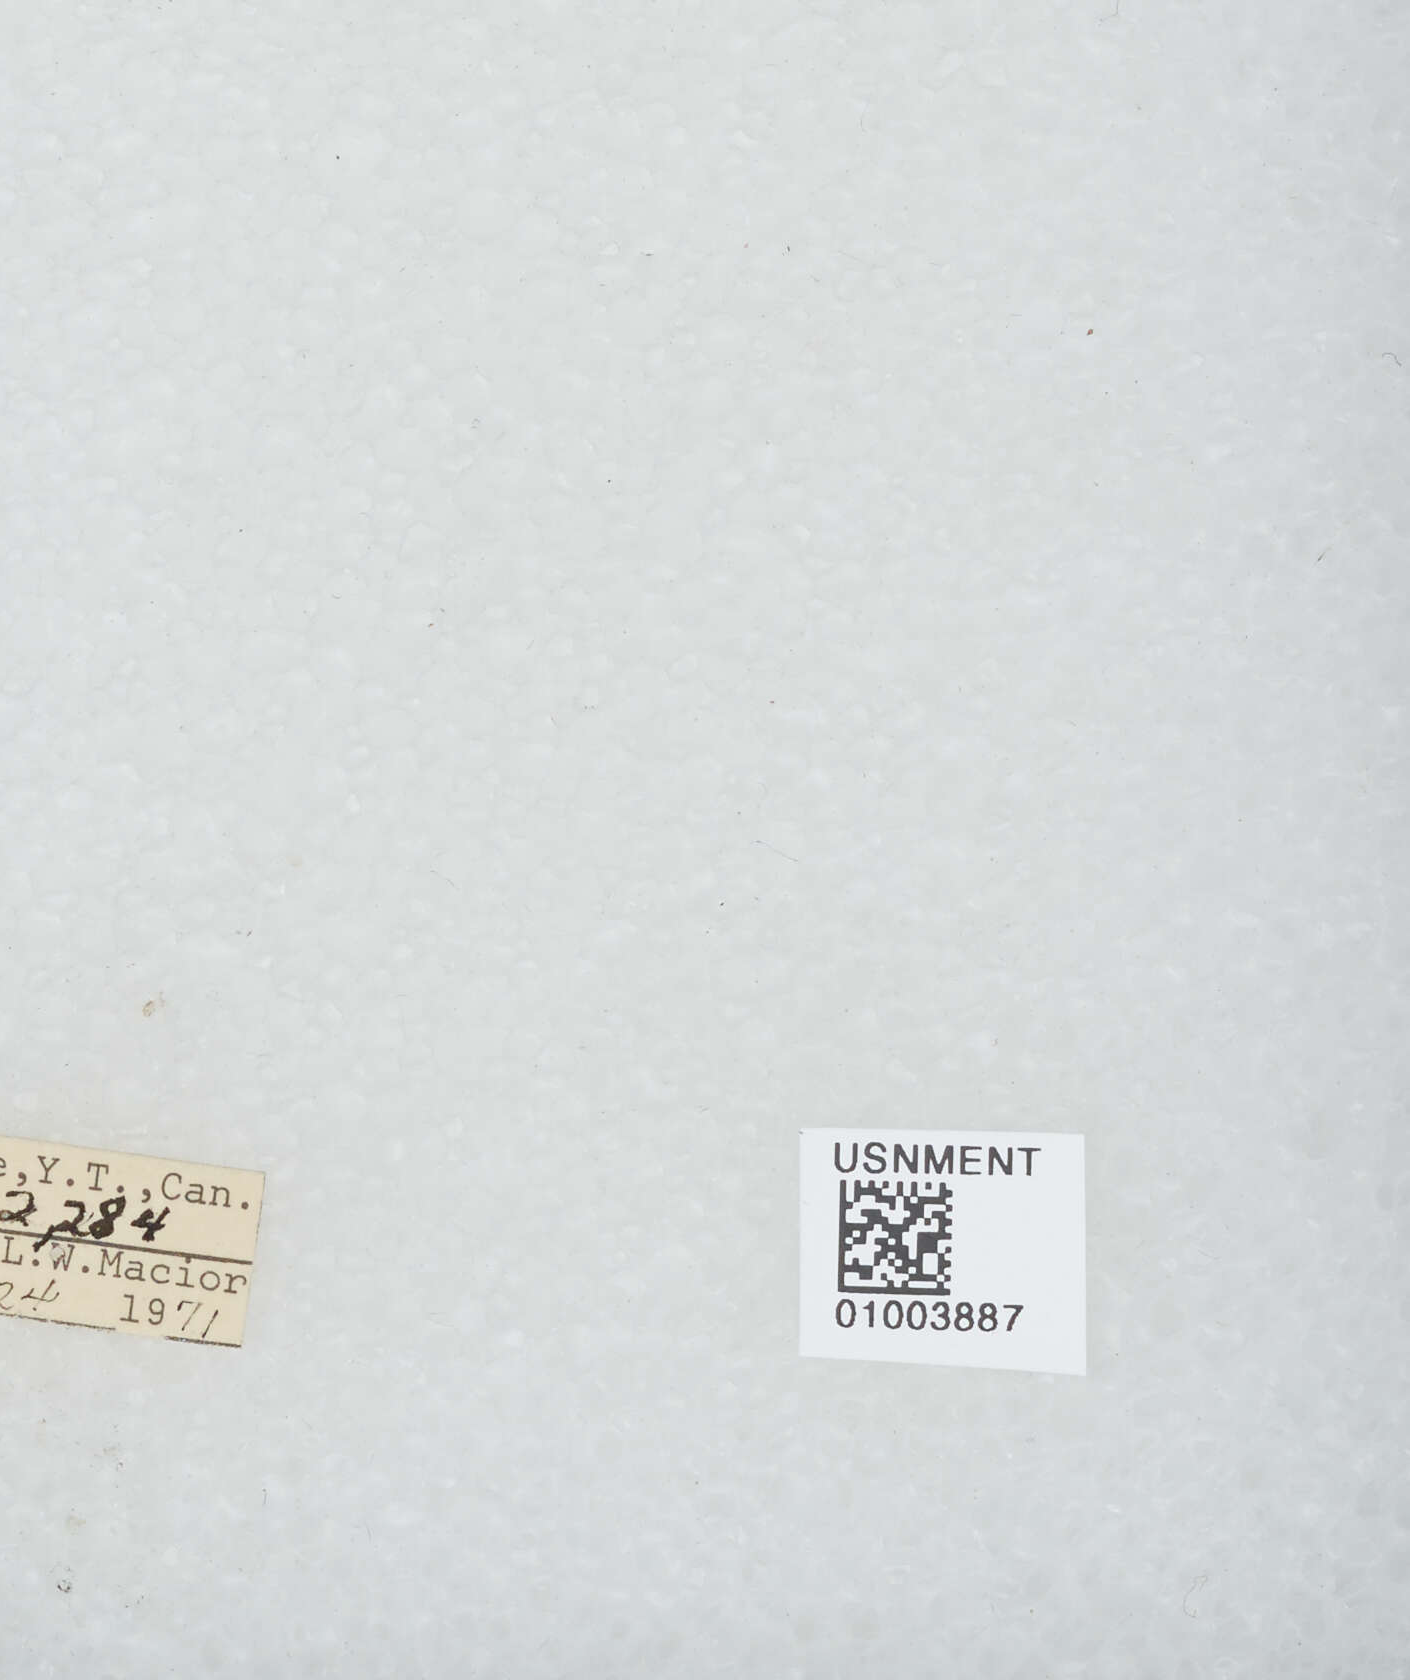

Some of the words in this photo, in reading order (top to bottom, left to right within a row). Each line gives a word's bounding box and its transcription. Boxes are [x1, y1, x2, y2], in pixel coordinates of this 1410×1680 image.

[834, 1142, 1041, 1176] USNMENT
[119, 1293, 219, 1338] 1971
[835, 1298, 1024, 1332] 01003887
